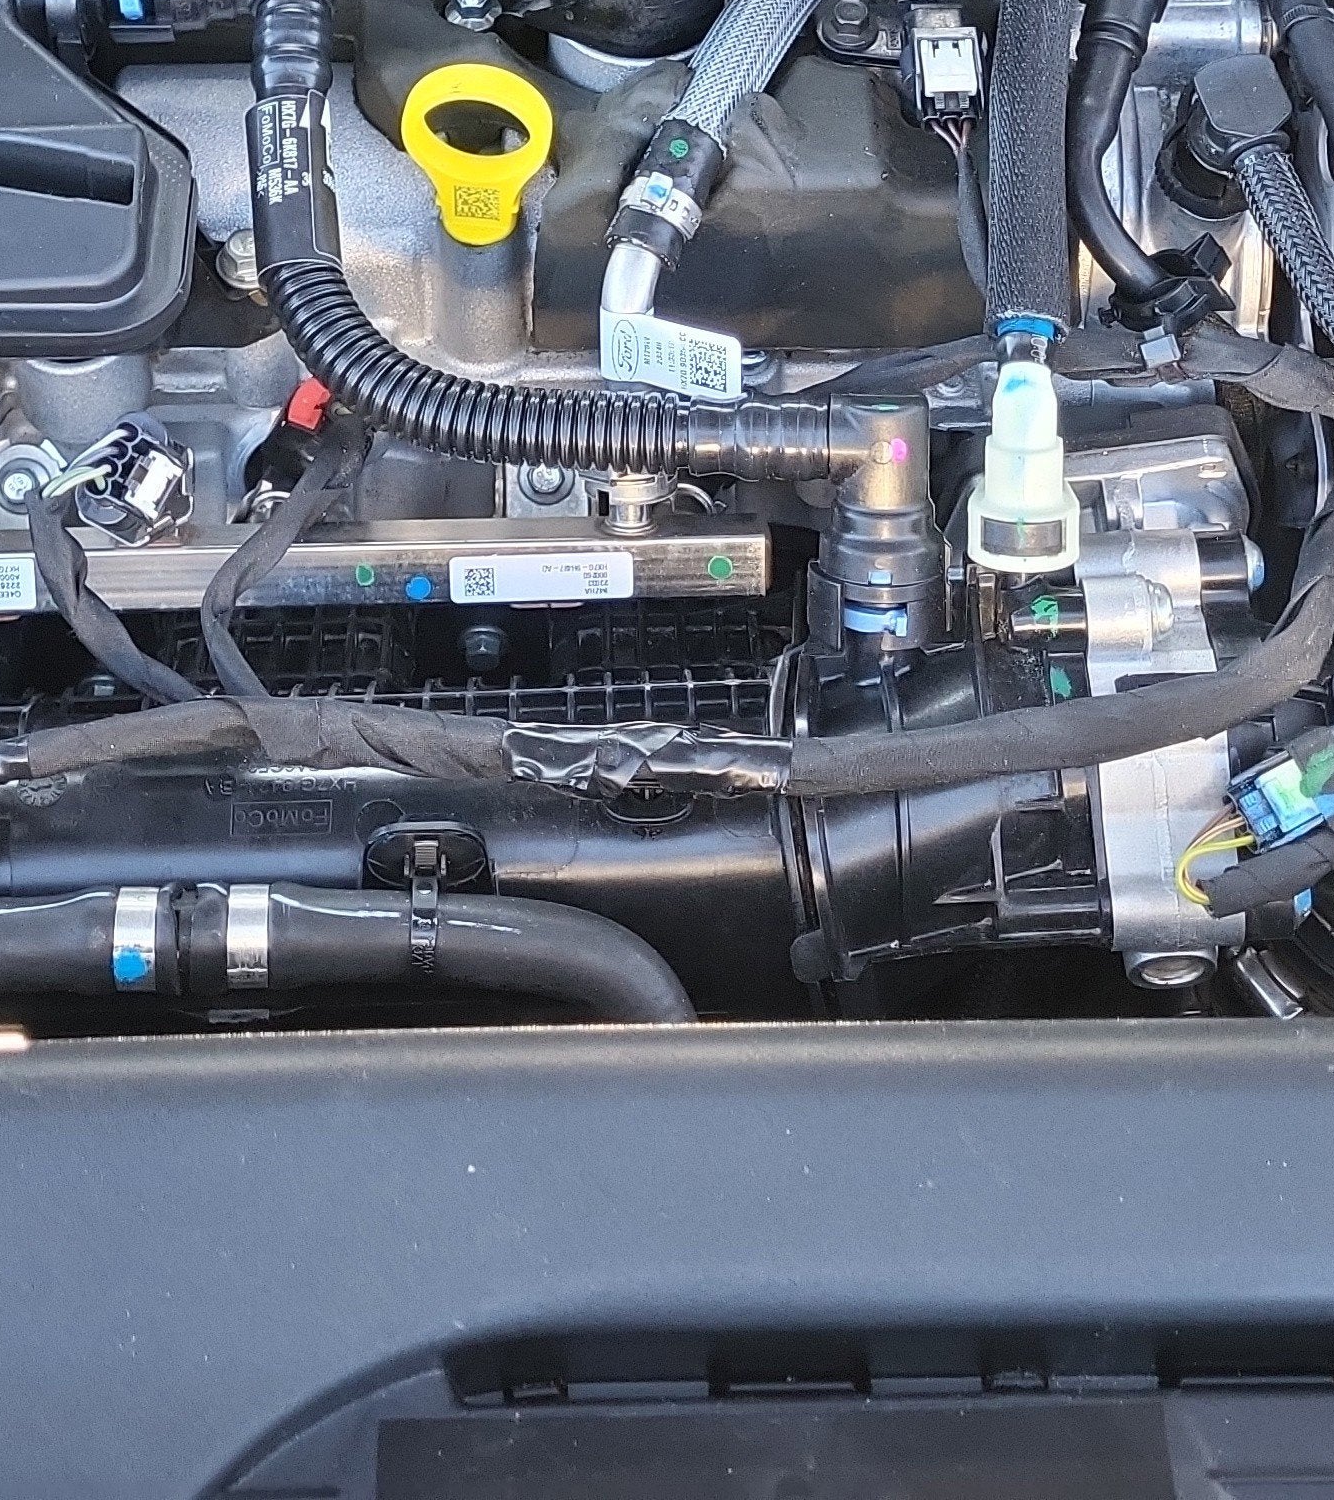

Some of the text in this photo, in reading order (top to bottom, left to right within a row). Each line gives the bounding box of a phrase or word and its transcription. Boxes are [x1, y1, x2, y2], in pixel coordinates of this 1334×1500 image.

[261, 107, 272, 164] FoMoCo
[617, 329, 632, 371] Ford
[233, 807, 327, 826] FoMoCo
